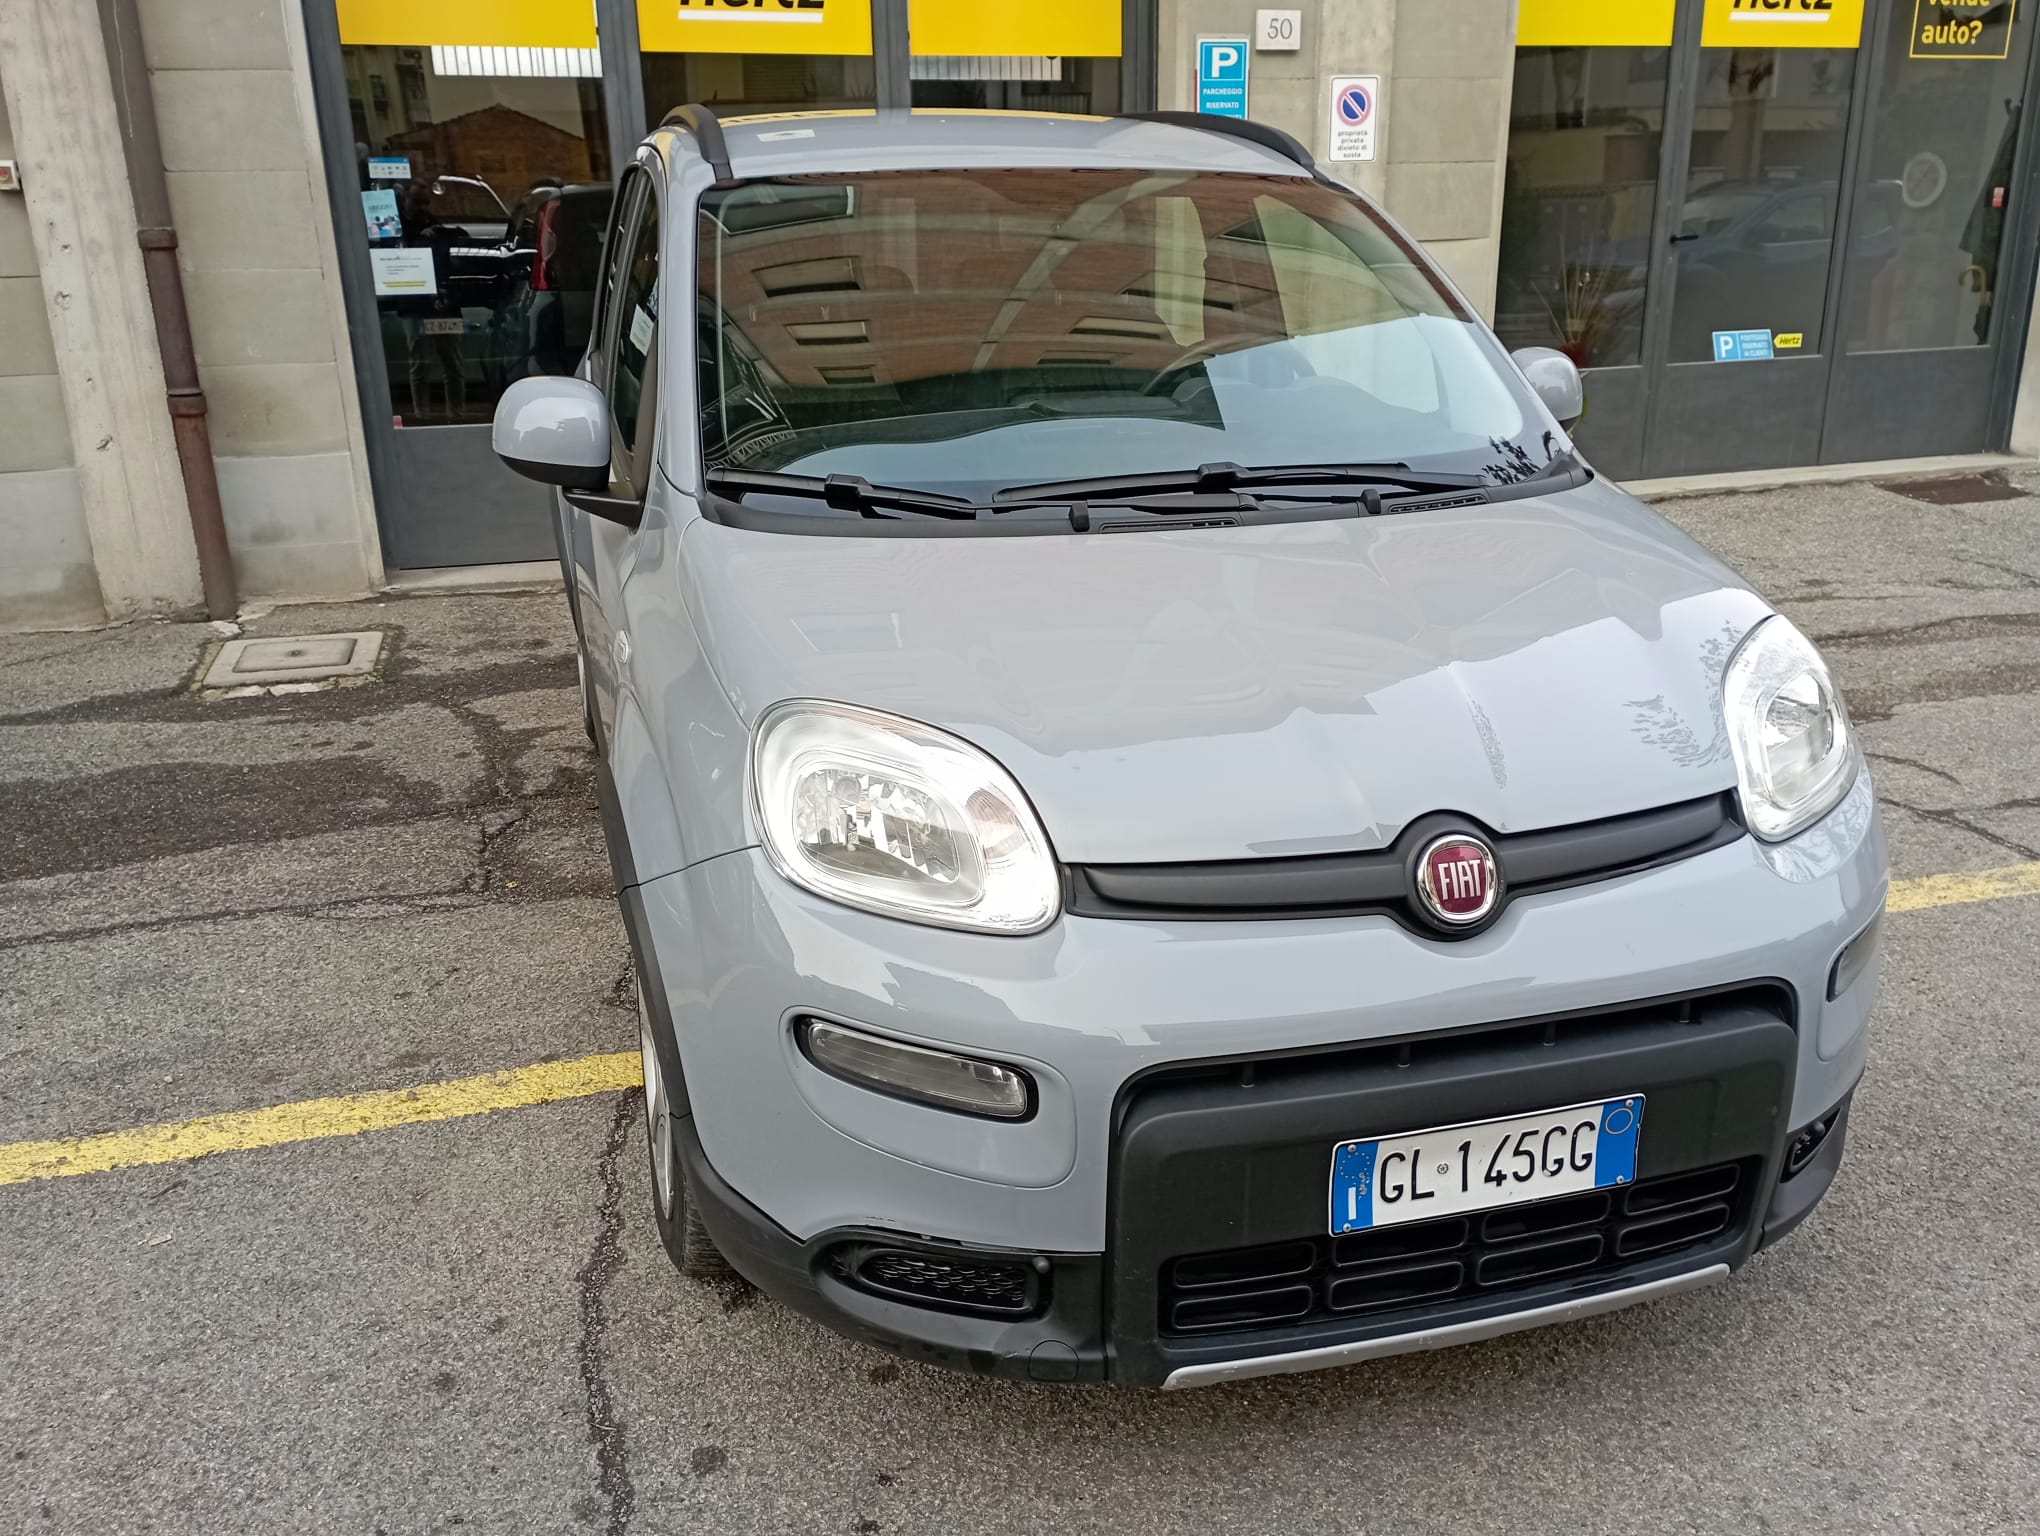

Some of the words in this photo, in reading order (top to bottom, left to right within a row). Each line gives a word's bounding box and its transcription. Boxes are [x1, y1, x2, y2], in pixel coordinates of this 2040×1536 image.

[1267, 18, 1293, 40] 50
[1921, 19, 1983, 45] auto?
[1211, 47, 1239, 78] P
[1203, 88, 1243, 96] PARCHEGGIO
[1720, 335, 1734, 358] P
[1779, 336, 1800, 345] Hertz
[1438, 859, 1481, 900] FIAT
